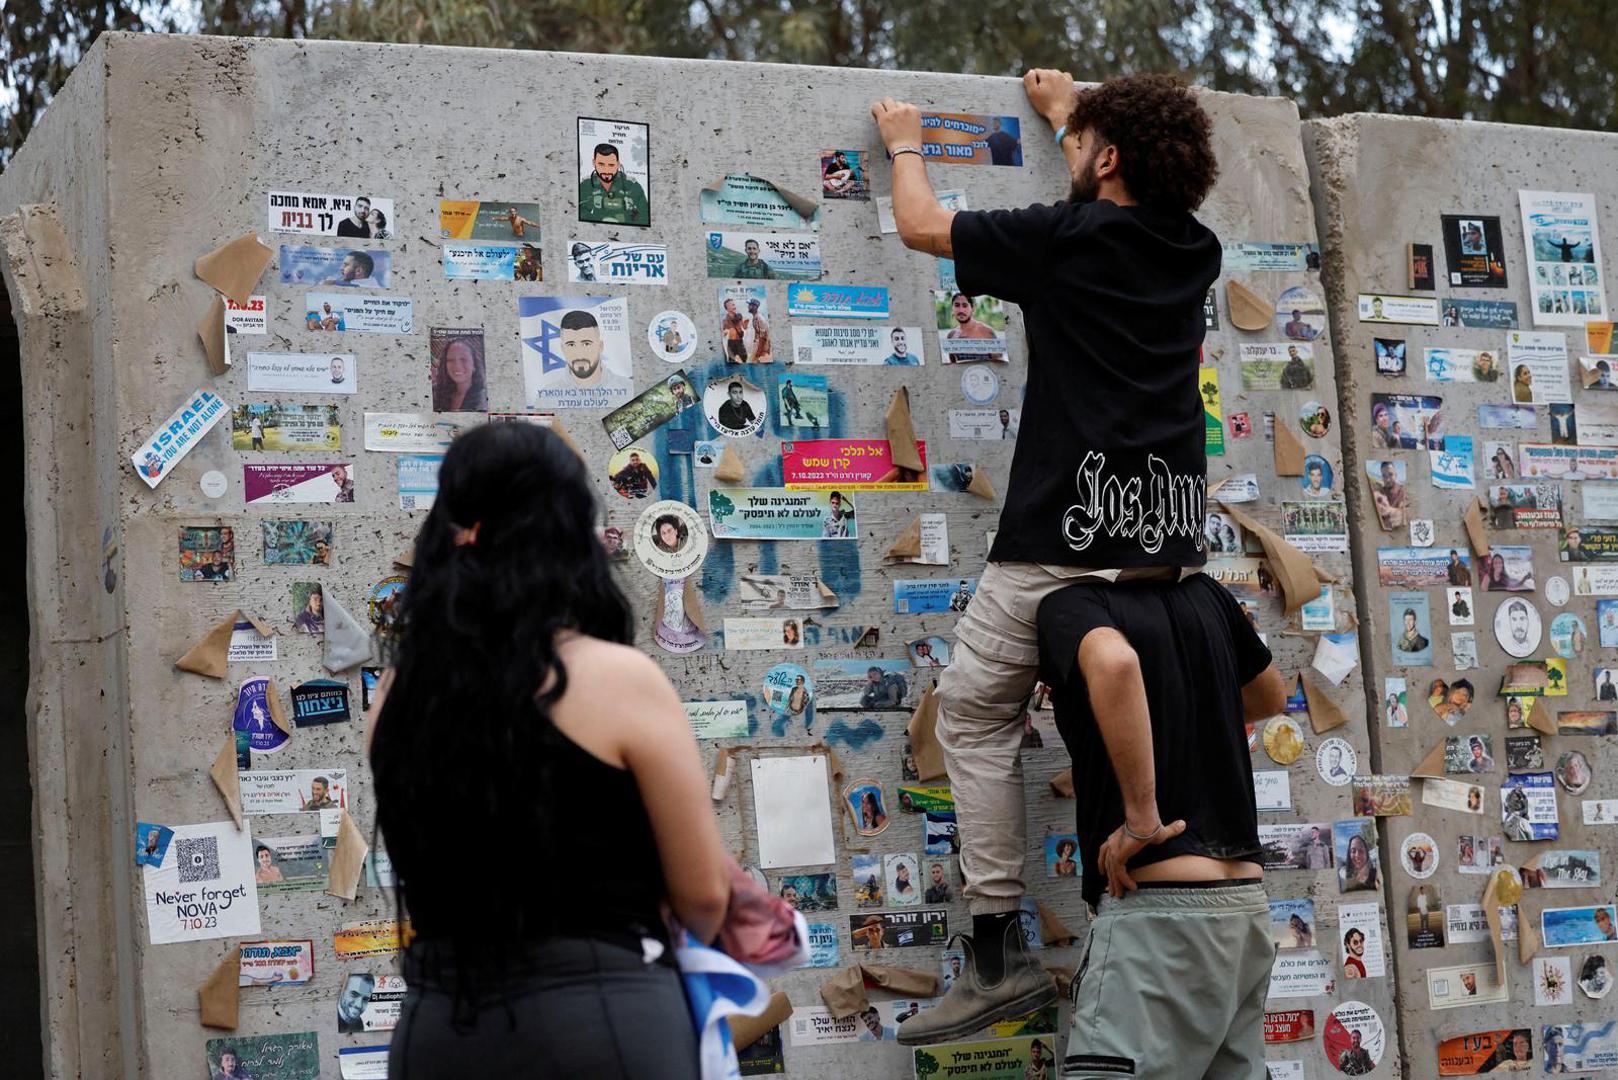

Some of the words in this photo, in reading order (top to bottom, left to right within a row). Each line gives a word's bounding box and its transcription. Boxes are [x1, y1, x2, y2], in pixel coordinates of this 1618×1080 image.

[921, 116, 942, 128] להיו
[945, 144, 974, 156] מאור
[270, 194, 299, 208] מחכה
[302, 196, 327, 209] אמא
[282, 211, 313, 228] בבית
[318, 212, 334, 232] לך
[765, 241, 780, 249] אני
[783, 239, 795, 250] לא
[474, 248, 485, 258] אל
[623, 250, 642, 262] של
[646, 253, 665, 263] עם
[611, 262, 665, 278] אריות
[386, 308, 396, 316] עם
[615, 388, 628, 396] דור
[584, 398, 609, 406] לעולם
[152, 392, 215, 452] ISRAEL
[162, 444, 177, 461] YOU
[175, 432, 190, 448] ARE
[187, 418, 203, 435] NOT
[200, 399, 224, 422] ALONE
[840, 445, 866, 457] תלכי
[867, 445, 884, 456] אל
[802, 457, 830, 468] שמש
[833, 457, 851, 470] קרן
[748, 495, 768, 507] שלך
[771, 496, 812, 507] "המנגינה
[739, 509, 775, 520] תיפסק"
[777, 507, 790, 518] לא
[793, 507, 822, 518] לעולם
[247, 648, 257, 656] של
[296, 692, 305, 701] לנו
[320, 689, 343, 698] במותם
[297, 696, 344, 717] ניצחון.
[156, 891, 197, 905] Never
[202, 884, 247, 909] forget
[177, 902, 218, 918] NOVA
[884, 913, 918, 924] זוהר
[922, 911, 945, 924] ירון
[1297, 959, 1307, 967] את
[810, 1016, 830, 1026] שלך
[815, 1025, 833, 1034] יאיר
[835, 1022, 857, 1032] לנצח
[951, 1051, 972, 1064] שלך
[973, 1047, 1013, 1060] "המנגינה
[982, 1061, 993, 1072] לא
[995, 1058, 1023, 1070] לעולם
